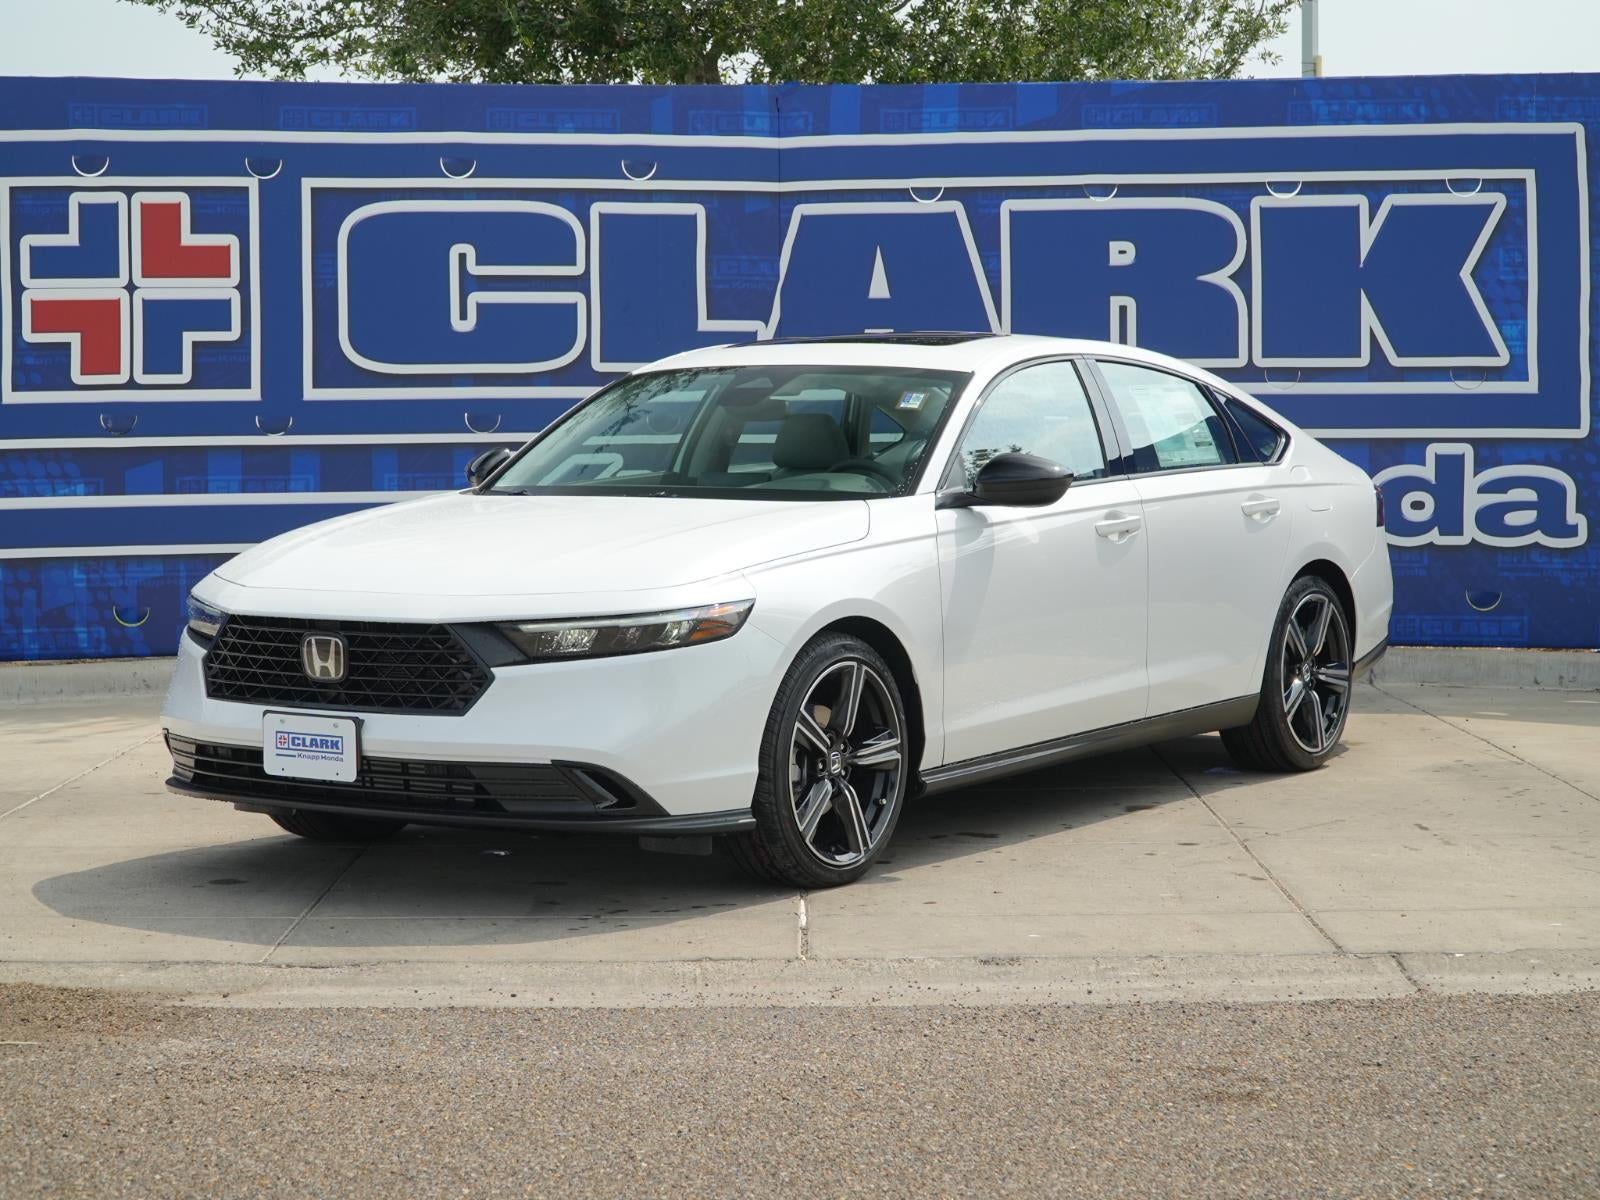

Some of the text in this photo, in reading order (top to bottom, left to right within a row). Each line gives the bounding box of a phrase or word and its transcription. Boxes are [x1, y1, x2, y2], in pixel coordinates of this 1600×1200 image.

[337, 193, 1510, 374] CLARK
[1373, 443, 1587, 548] da
[291, 736, 340, 750] CLARK
[297, 752, 344, 763] Knapp Honda
